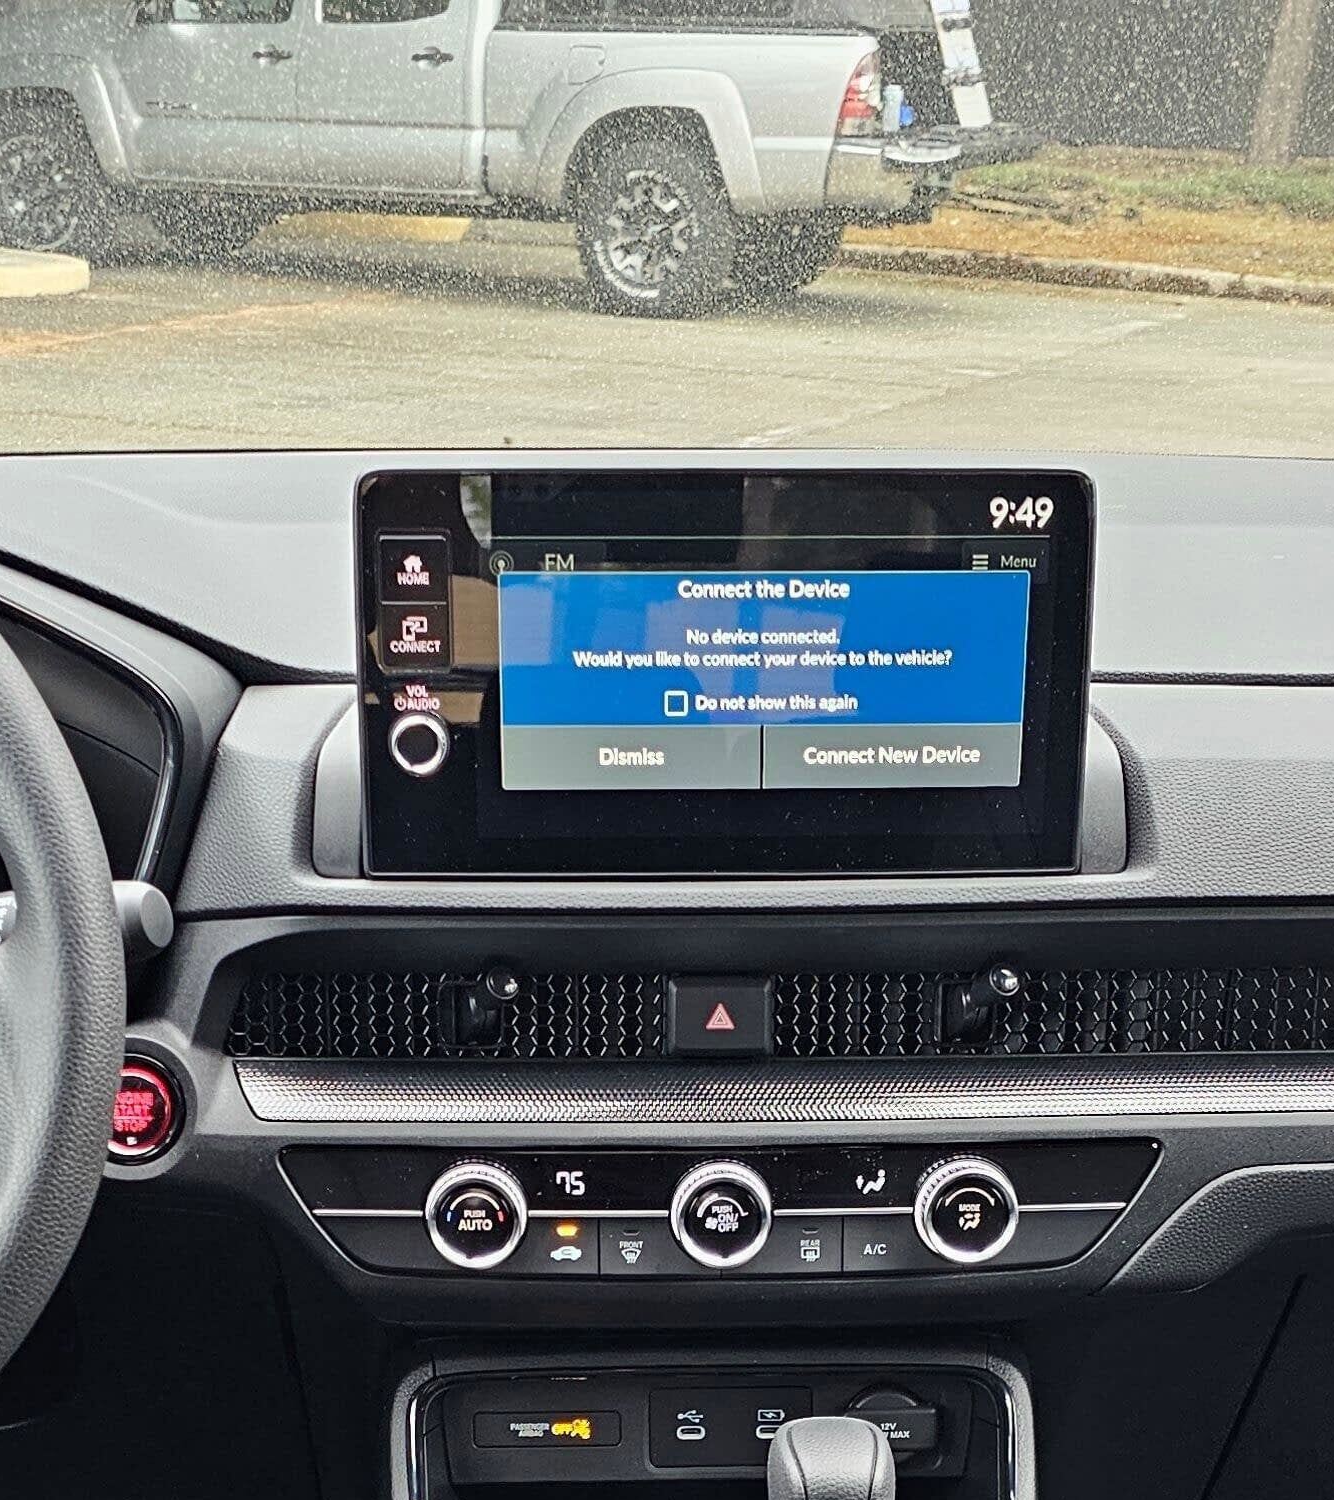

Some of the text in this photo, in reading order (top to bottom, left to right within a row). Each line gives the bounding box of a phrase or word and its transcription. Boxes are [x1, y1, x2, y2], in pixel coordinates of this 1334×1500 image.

[989, 496, 1055, 529] 9:49
[544, 553, 575, 571] FM
[1000, 555, 1037, 569] Menu
[396, 571, 430, 586] HOME
[677, 579, 851, 599] Connect the Device
[686, 628, 841, 645] No device connected.
[389, 640, 441, 653] CONNECT
[572, 649, 953, 670] Would you like to connect your device to the vehicle?
[405, 685, 429, 698] VOL
[407, 697, 441, 711] AUDIO
[695, 694, 858, 713] Do not show this again
[598, 747, 665, 766] Dismiss
[803, 745, 981, 765] Connect New Device
[555, 1171, 586, 1196] 75
[463, 1209, 486, 1218] PUSH
[711, 1204, 733, 1214] PUSH
[958, 1203, 982, 1212] MODE
[457, 1218, 493, 1232] AUTO
[717, 1221, 739, 1233] OFF
[619, 1240, 644, 1249] FRONT
[799, 1239, 821, 1248] REAR
[863, 1243, 887, 1255] A/C
[880, 1422, 897, 1431] 12V
[890, 1430, 911, 1439] MAX
